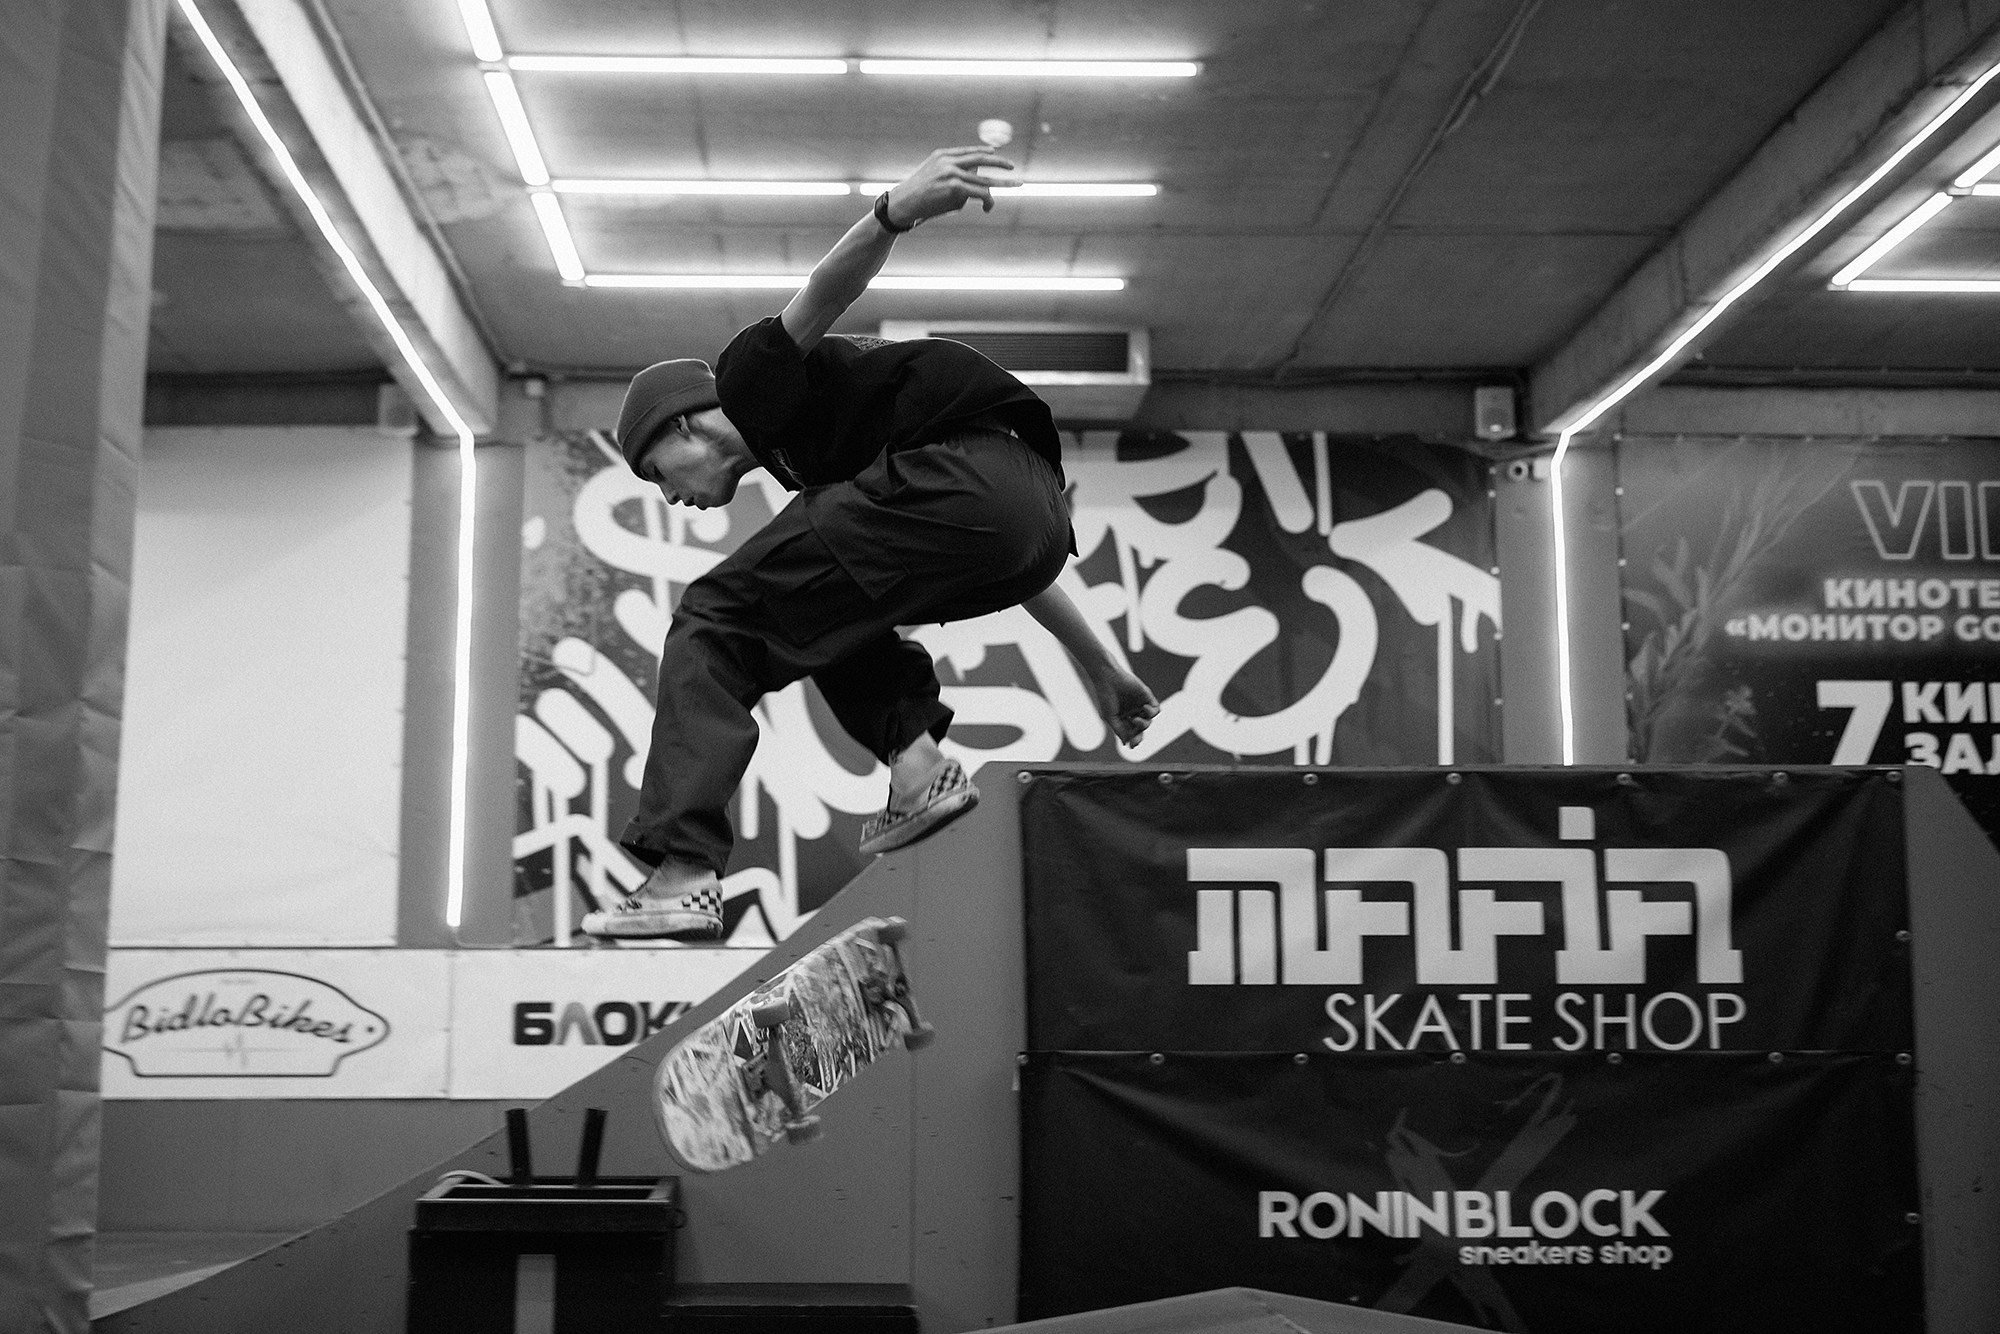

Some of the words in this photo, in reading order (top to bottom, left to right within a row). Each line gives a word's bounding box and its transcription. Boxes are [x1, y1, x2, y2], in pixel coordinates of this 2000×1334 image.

[1725, 614, 1945, 641] «МОНИТОР
[1816, 679, 1893, 766] 7
[120, 993, 352, 1044] BidloBikes
[1322, 992, 1532, 1052] SKATE
[1552, 991, 1747, 1051] SHOP
[1458, 1240, 1594, 1265] sneakers
[1600, 1241, 1673, 1270] shop
